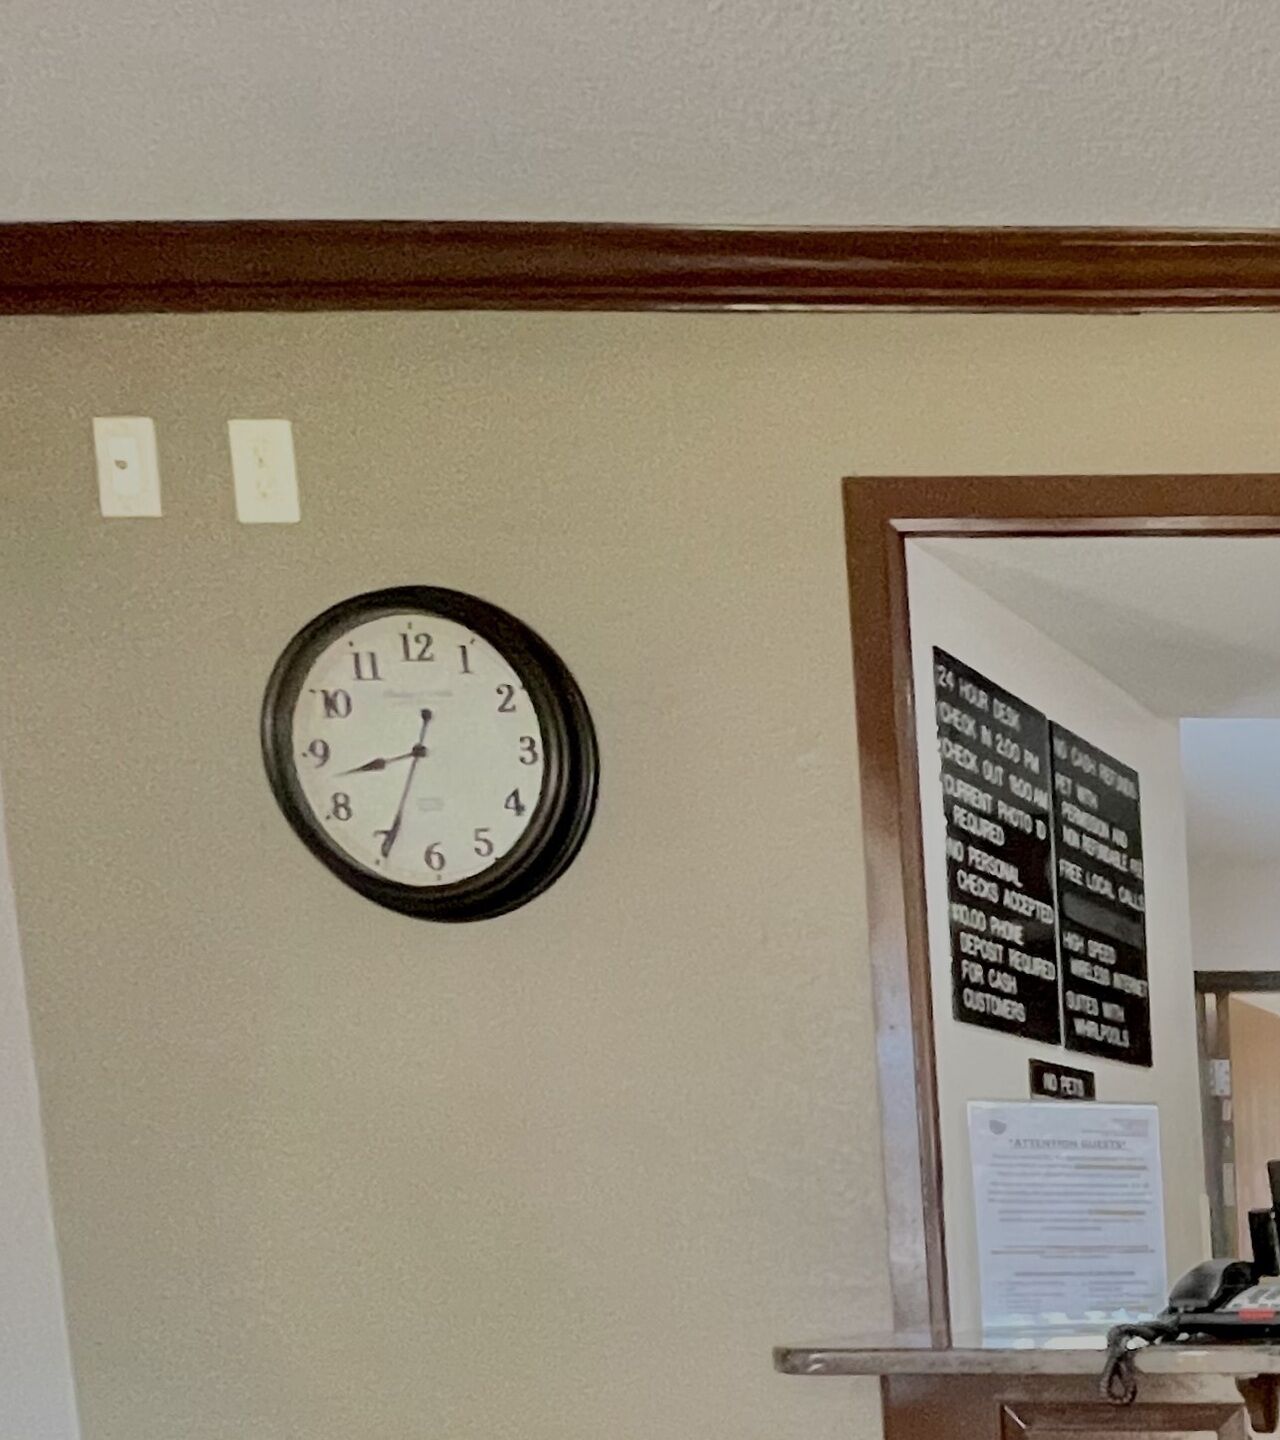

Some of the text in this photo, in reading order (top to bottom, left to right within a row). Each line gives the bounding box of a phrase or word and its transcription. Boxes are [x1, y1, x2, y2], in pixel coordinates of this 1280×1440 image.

[400, 632, 434, 662] 12
[459, 645, 474, 674] 1
[352, 651, 383, 681] 11
[937, 664, 955, 691] 24
[319, 689, 352, 718] 10
[496, 684, 516, 713] 2
[938, 701, 977, 739] CHECK
[308, 739, 330, 768] 9
[519, 736, 538, 765] 3
[940, 737, 979, 773] CHECK
[330, 792, 353, 821] 8
[504, 788, 525, 816] 4
[953, 804, 1005, 846] REQUIRED
[373, 829, 393, 858] 7
[424, 842, 446, 871] 6
[474, 828, 493, 857] 5
[961, 959, 985, 985] FOR
